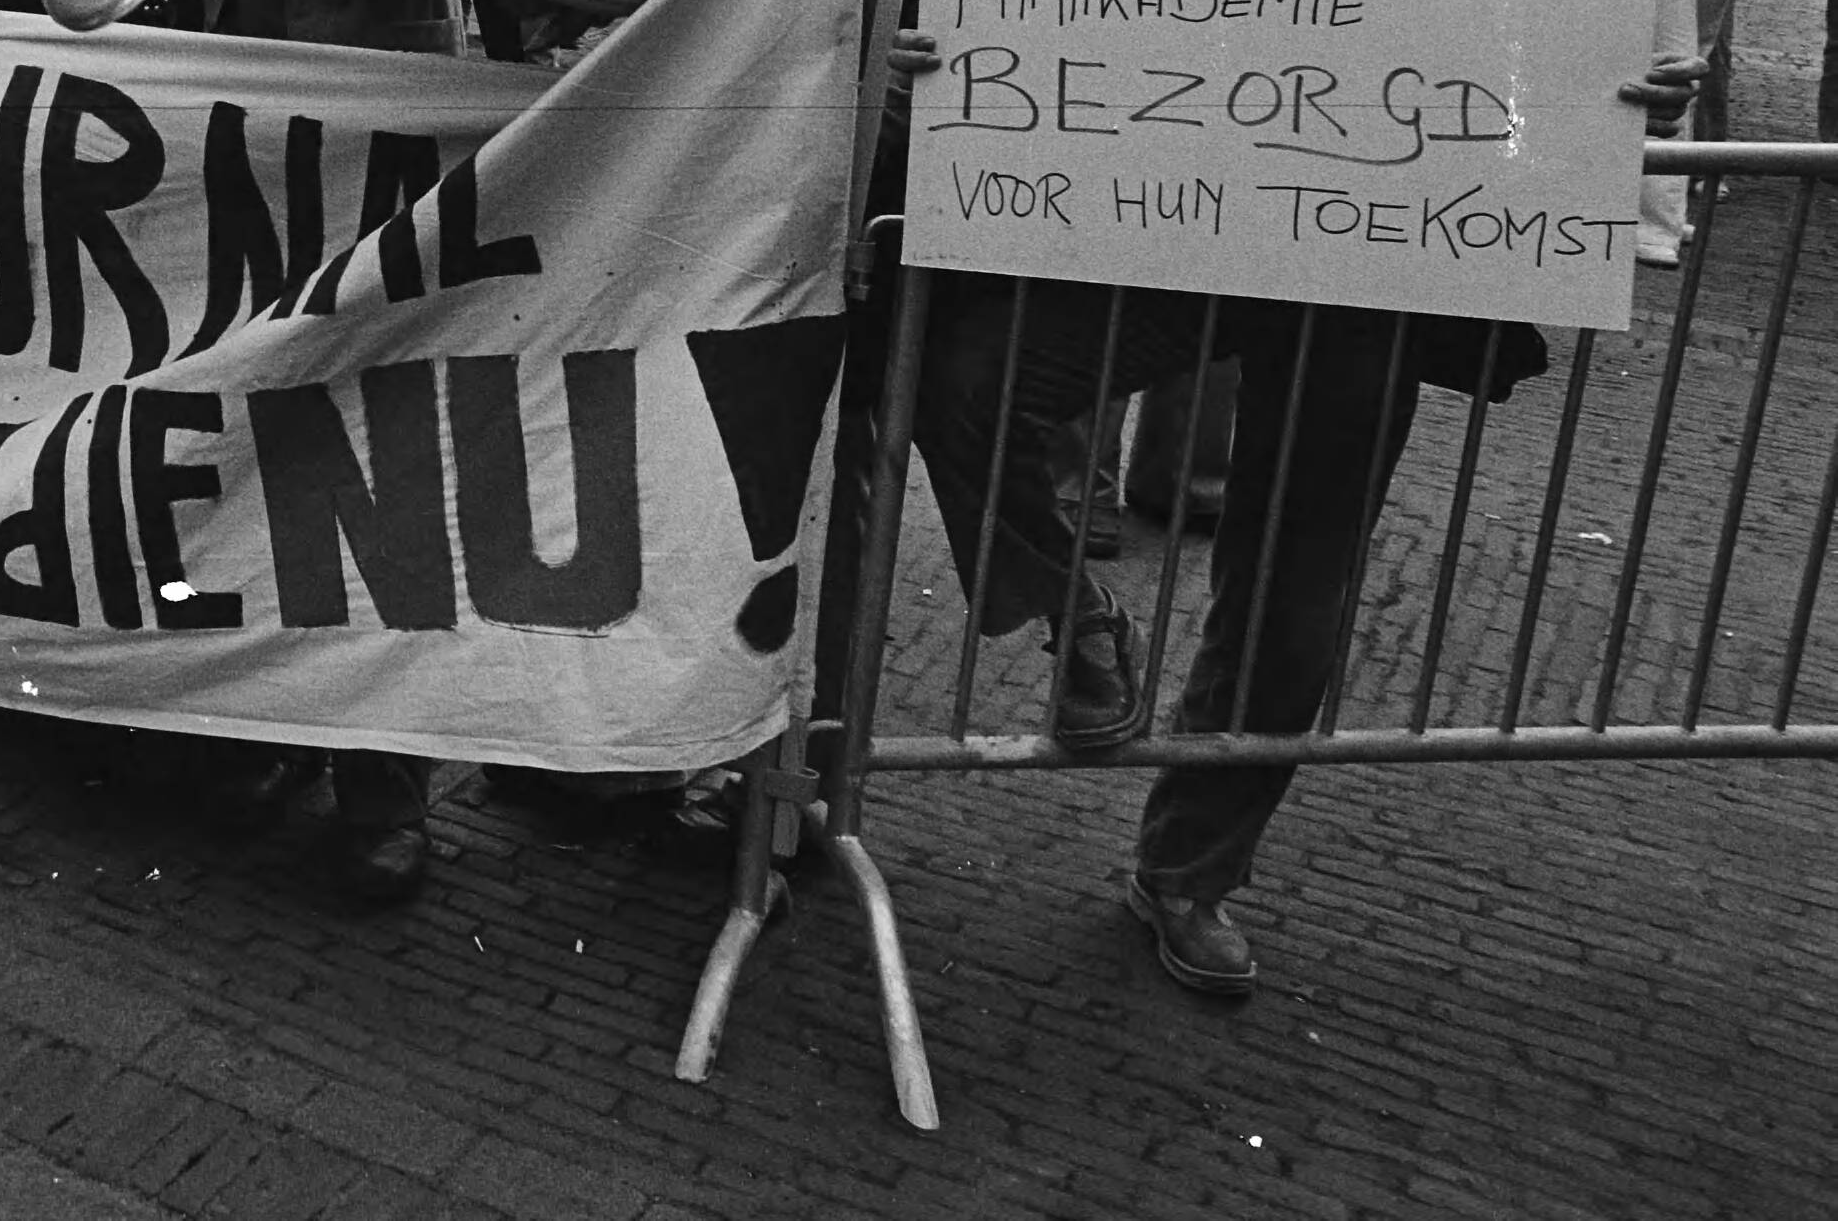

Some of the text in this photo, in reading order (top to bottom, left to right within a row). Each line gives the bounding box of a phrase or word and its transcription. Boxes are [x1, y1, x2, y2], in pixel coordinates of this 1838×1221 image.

[928, 45, 1514, 166] BEZORGD
[952, 161, 1640, 267] VOOR HUN TOEKOMST
